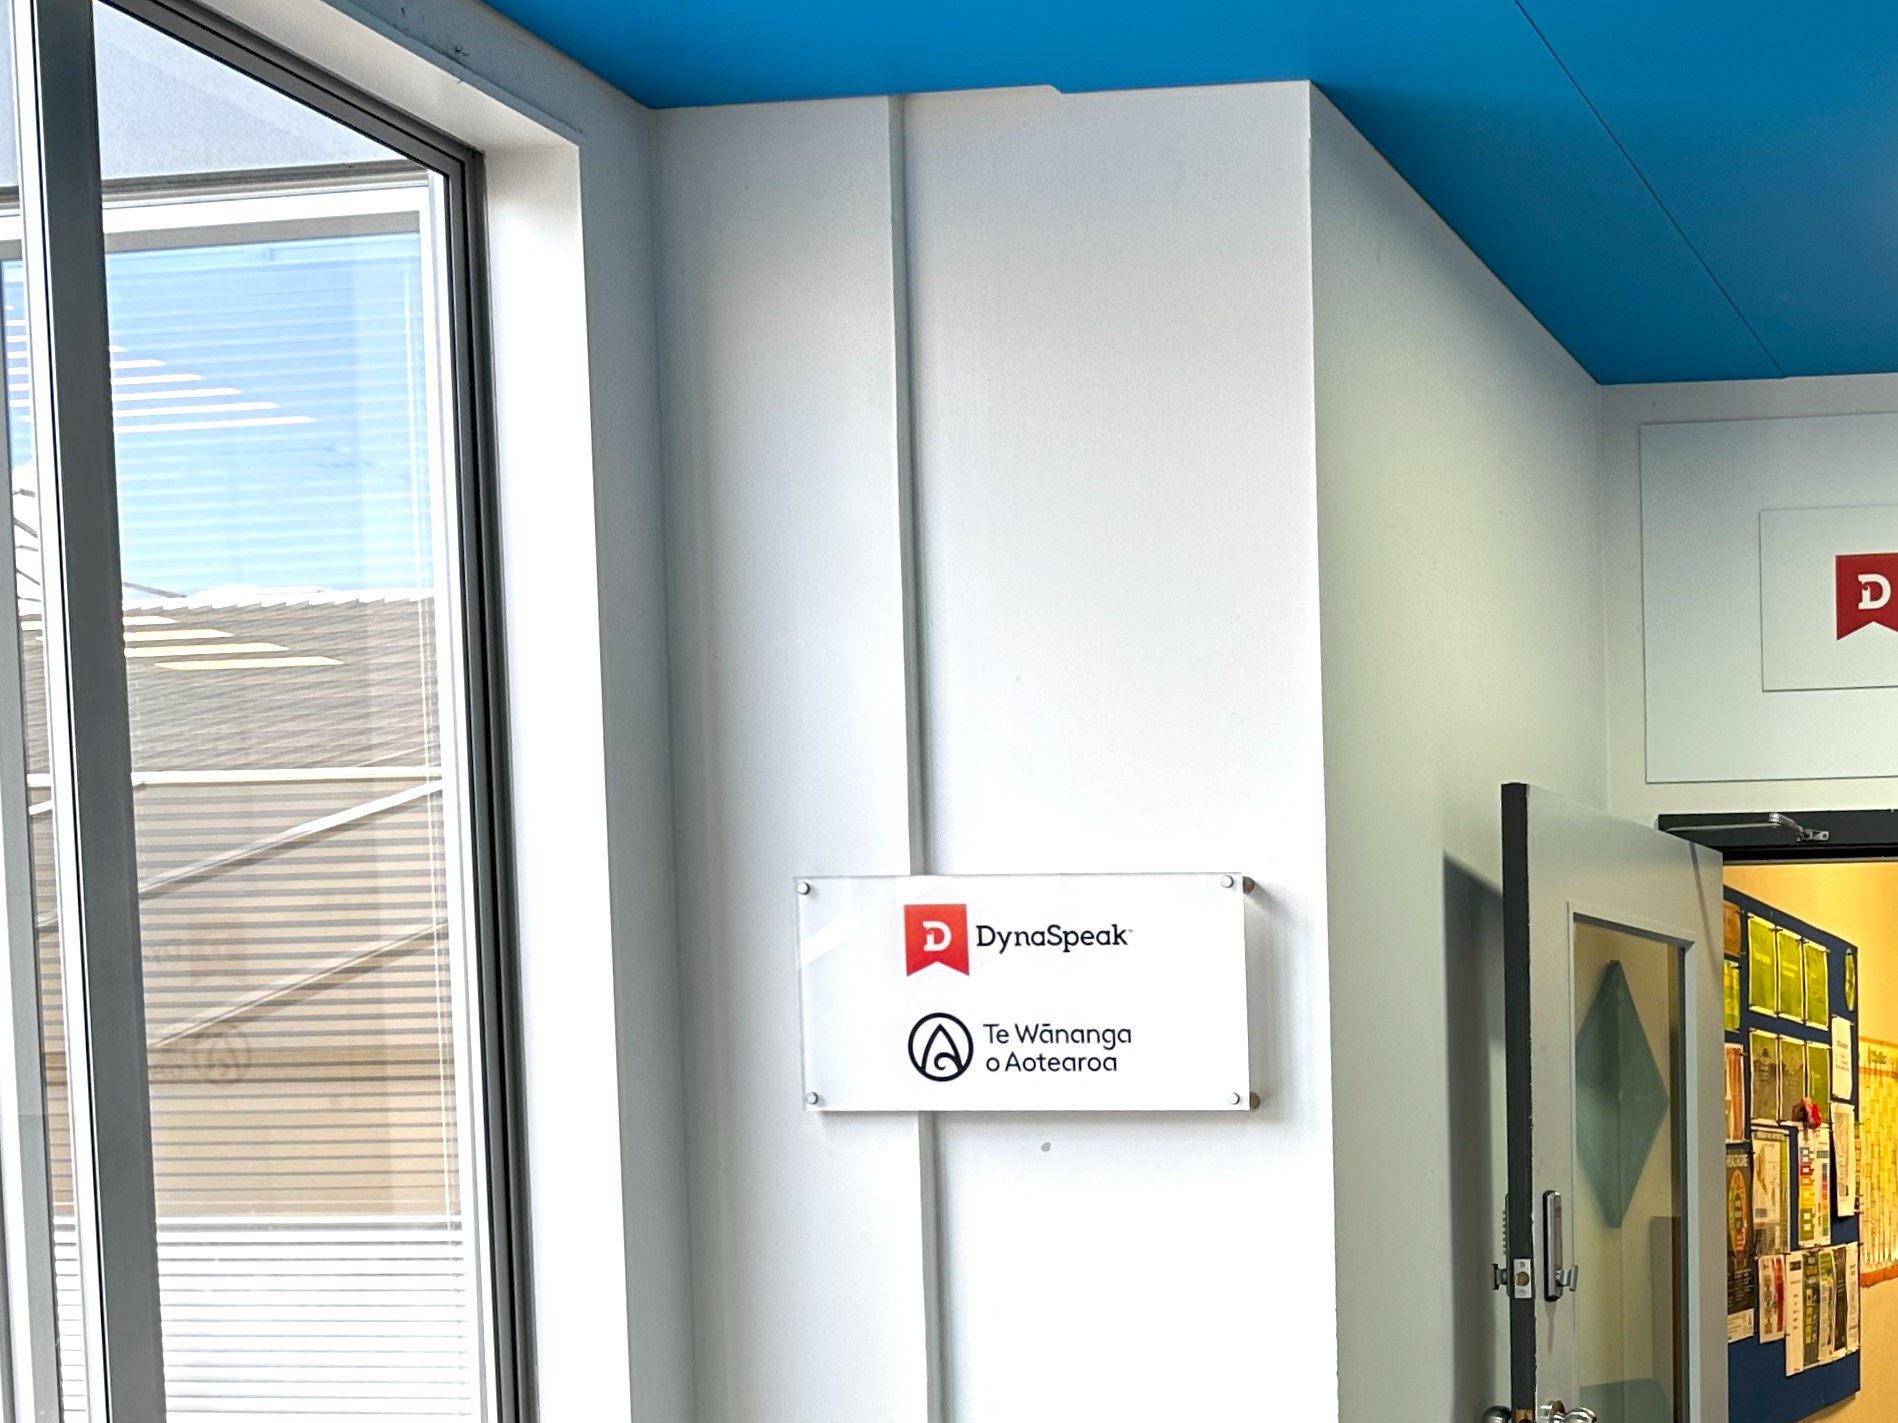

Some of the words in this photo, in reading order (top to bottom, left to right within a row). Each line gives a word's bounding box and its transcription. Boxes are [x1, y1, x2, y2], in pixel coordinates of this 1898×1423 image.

[975, 923, 1129, 954] DynaSpeak
[983, 1023, 1009, 1044] Te
[1013, 1023, 1132, 1050] Wānanga
[986, 1058, 1000, 1073] o
[1004, 1051, 1118, 1073] Aotearoa
